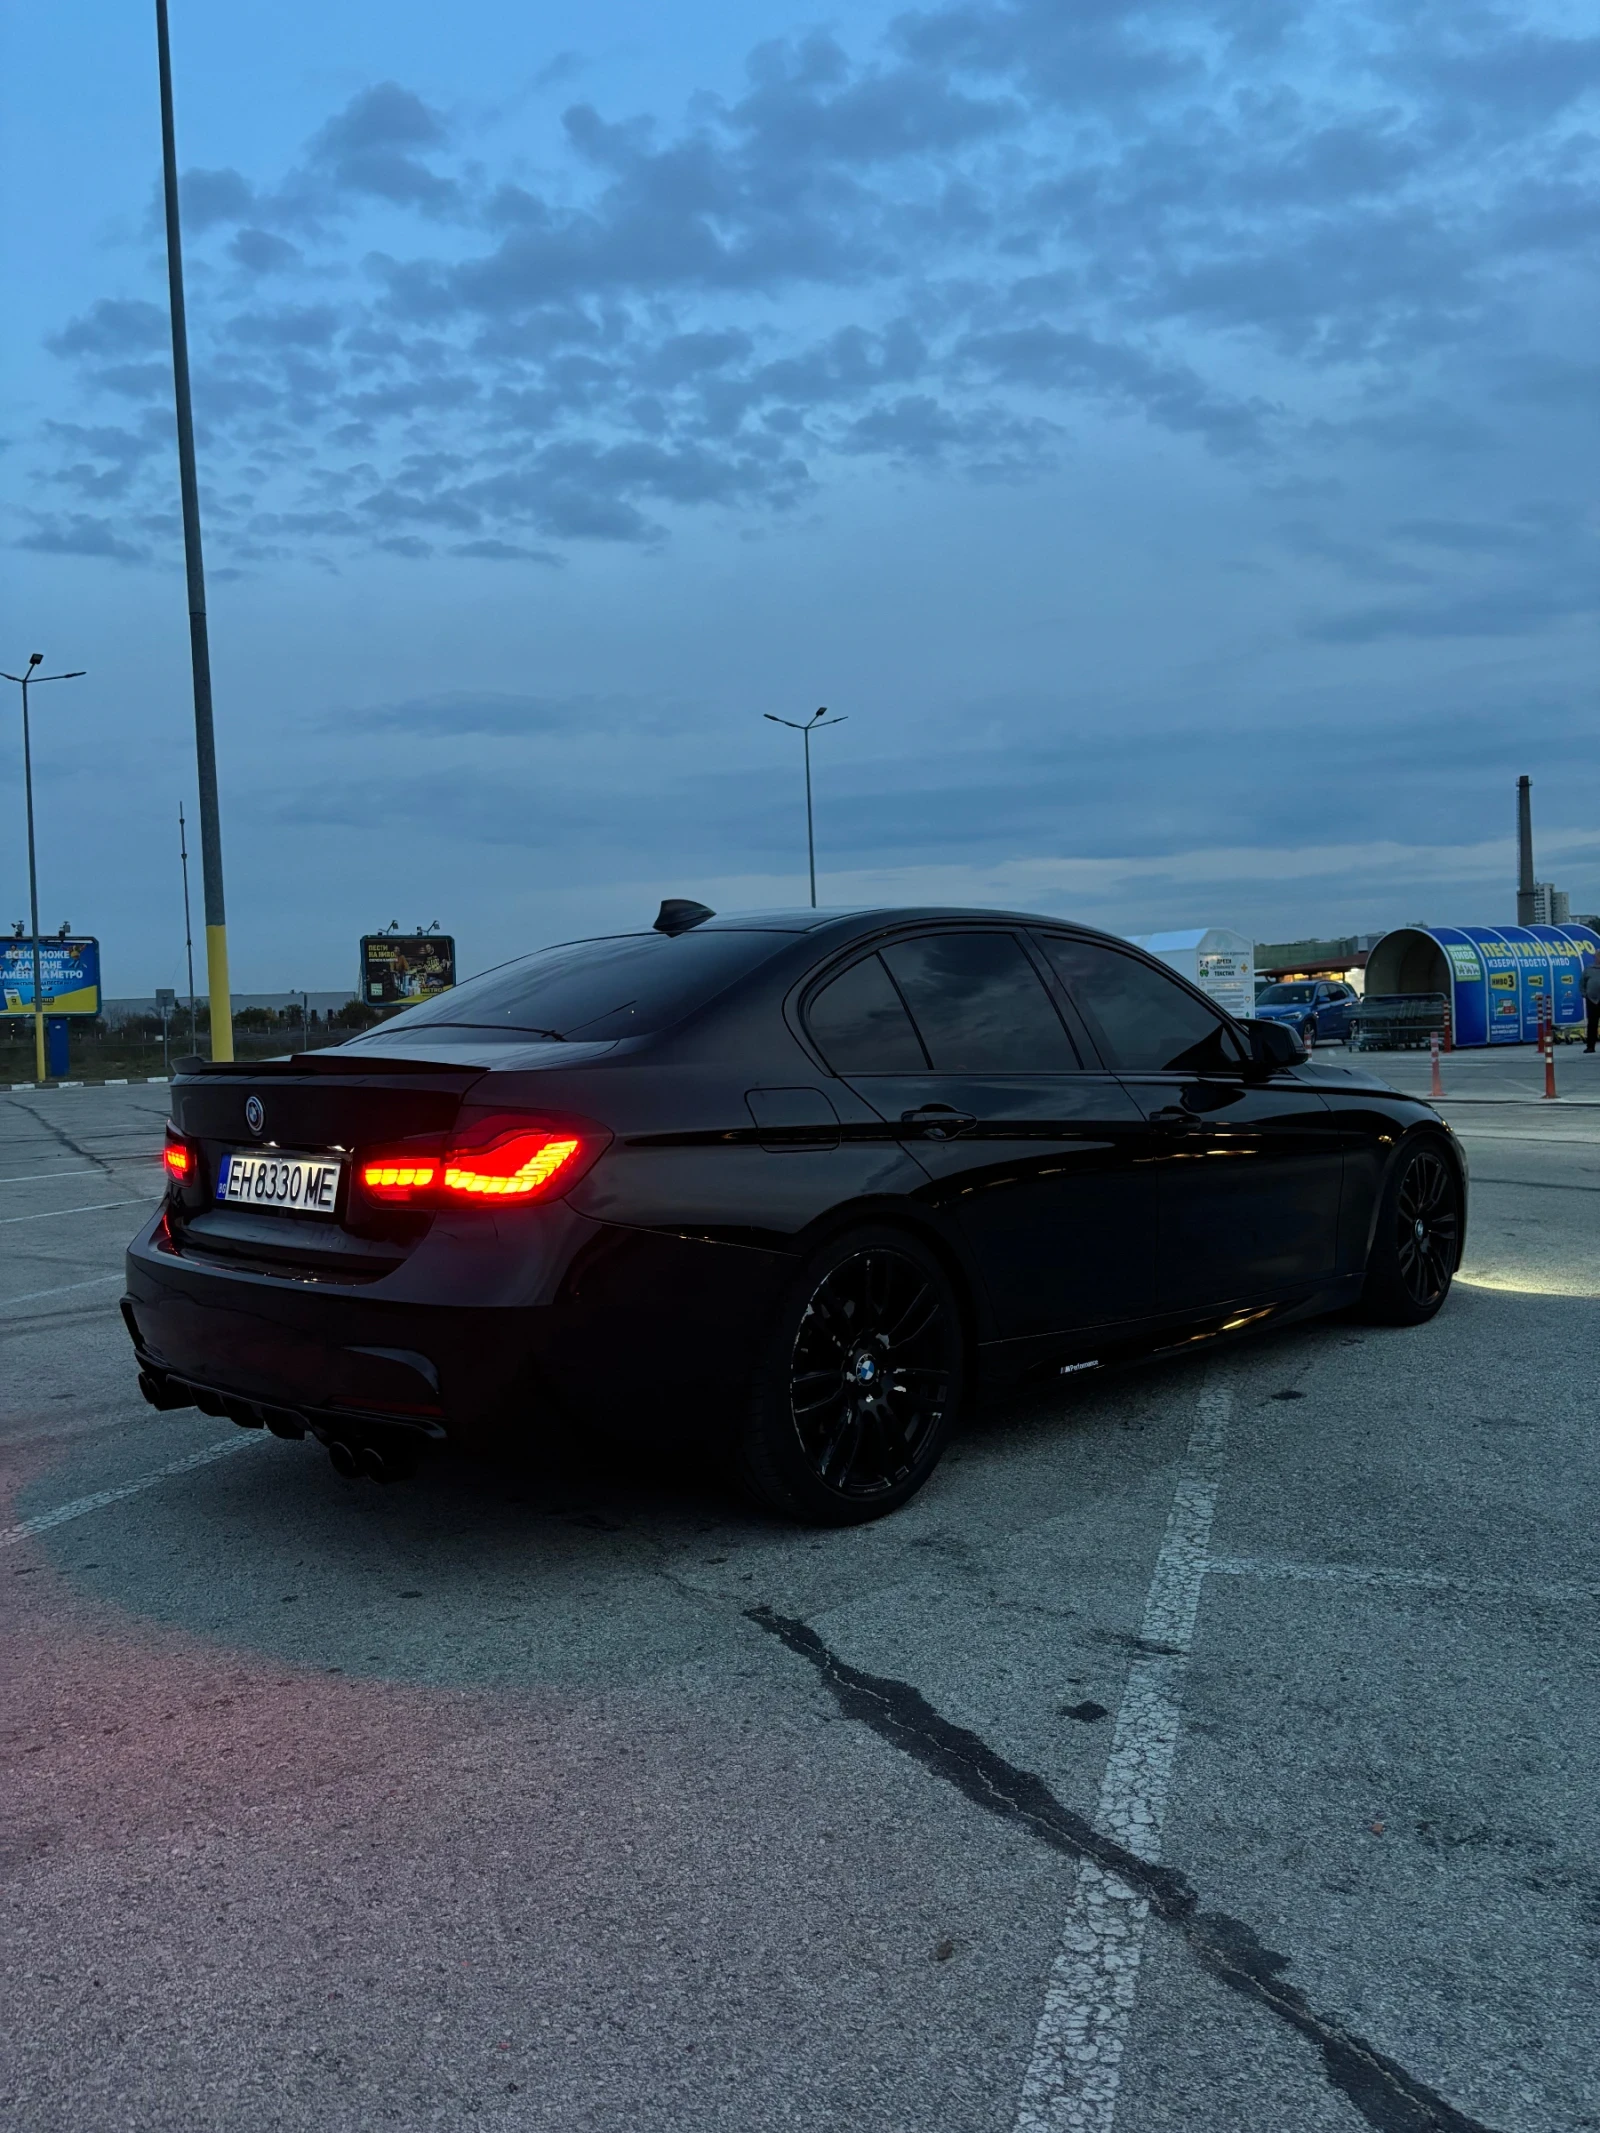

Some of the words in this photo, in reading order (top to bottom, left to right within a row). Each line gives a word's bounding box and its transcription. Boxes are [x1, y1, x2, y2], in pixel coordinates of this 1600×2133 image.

[1479, 943, 1534, 957] ПЕСТИ
[1530, 942, 1557, 957] НА
[1553, 940, 1596, 957] ЕДРО
[40, 951, 70, 959] МОЖЕ
[1451, 951, 1477, 960] НИВО
[32, 961, 62, 969] ТАНЕ
[1487, 958, 1517, 968] ИЗБЕРИ
[1520, 958, 1548, 968] ТВОЕТО
[1551, 957, 1570, 966] НИВО
[50, 970, 83, 978] МЕТРО
[1508, 975, 1515, 988] 3
[228, 1160, 255, 1198] EH
[255, 1163, 302, 1201] 8330
[304, 1166, 336, 1206] ME
